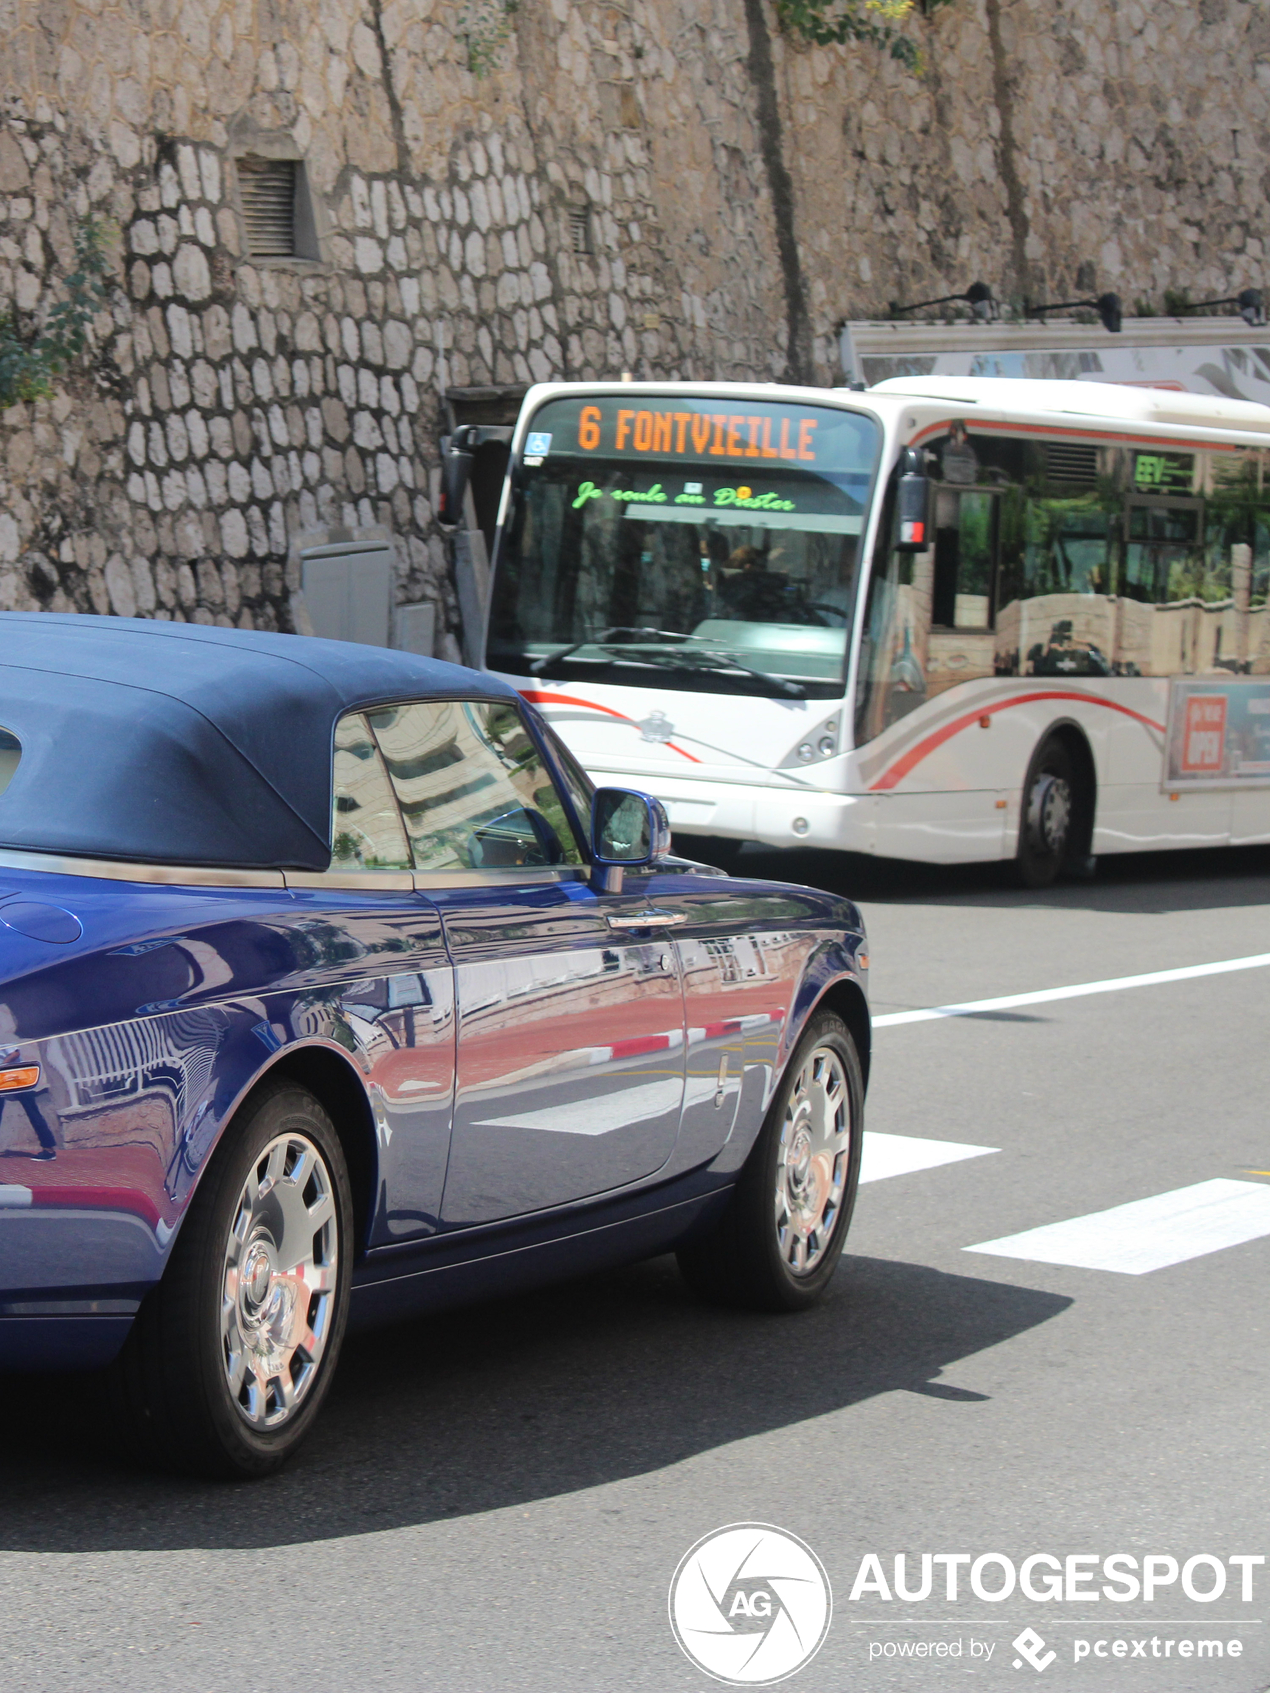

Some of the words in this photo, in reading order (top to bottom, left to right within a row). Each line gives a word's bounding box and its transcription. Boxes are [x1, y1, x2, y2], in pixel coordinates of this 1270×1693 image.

[578, 406, 601, 450] 6
[615, 408, 818, 460] FONTVIEILLE
[572, 481, 603, 509] Je
[610, 483, 668, 503] roule
[674, 493, 706, 504] au
